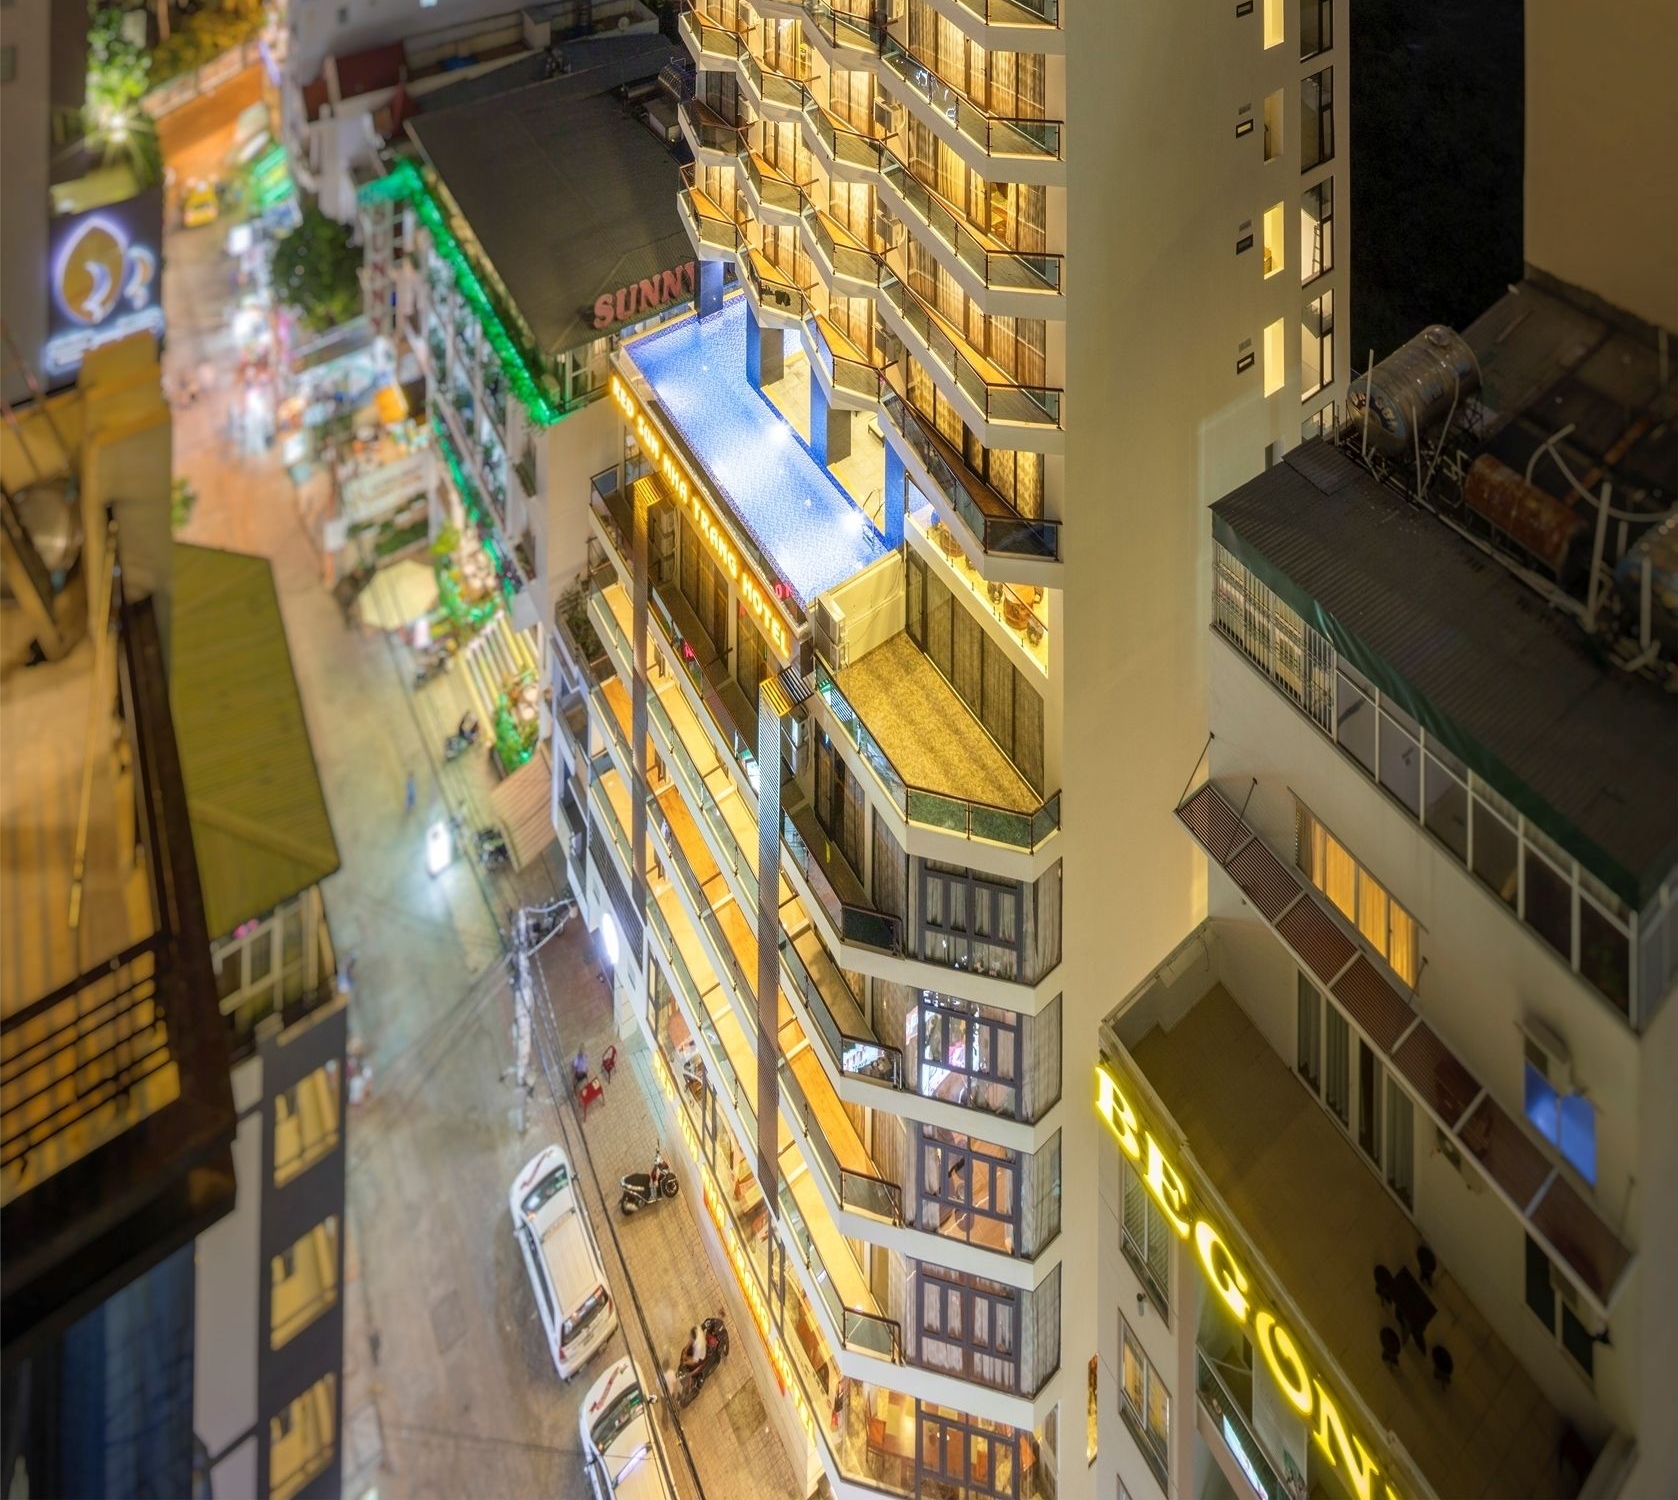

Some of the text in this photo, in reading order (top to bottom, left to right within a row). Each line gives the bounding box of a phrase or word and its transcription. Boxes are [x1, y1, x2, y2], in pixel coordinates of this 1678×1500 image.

[612, 375, 635, 418] RED
[637, 414, 660, 461] SUN
[662, 452, 688, 504] NHA
[692, 496, 738, 580] TRANG
[742, 571, 790, 660] HOTEL
[1094, 1066, 1397, 1500] BEGON
